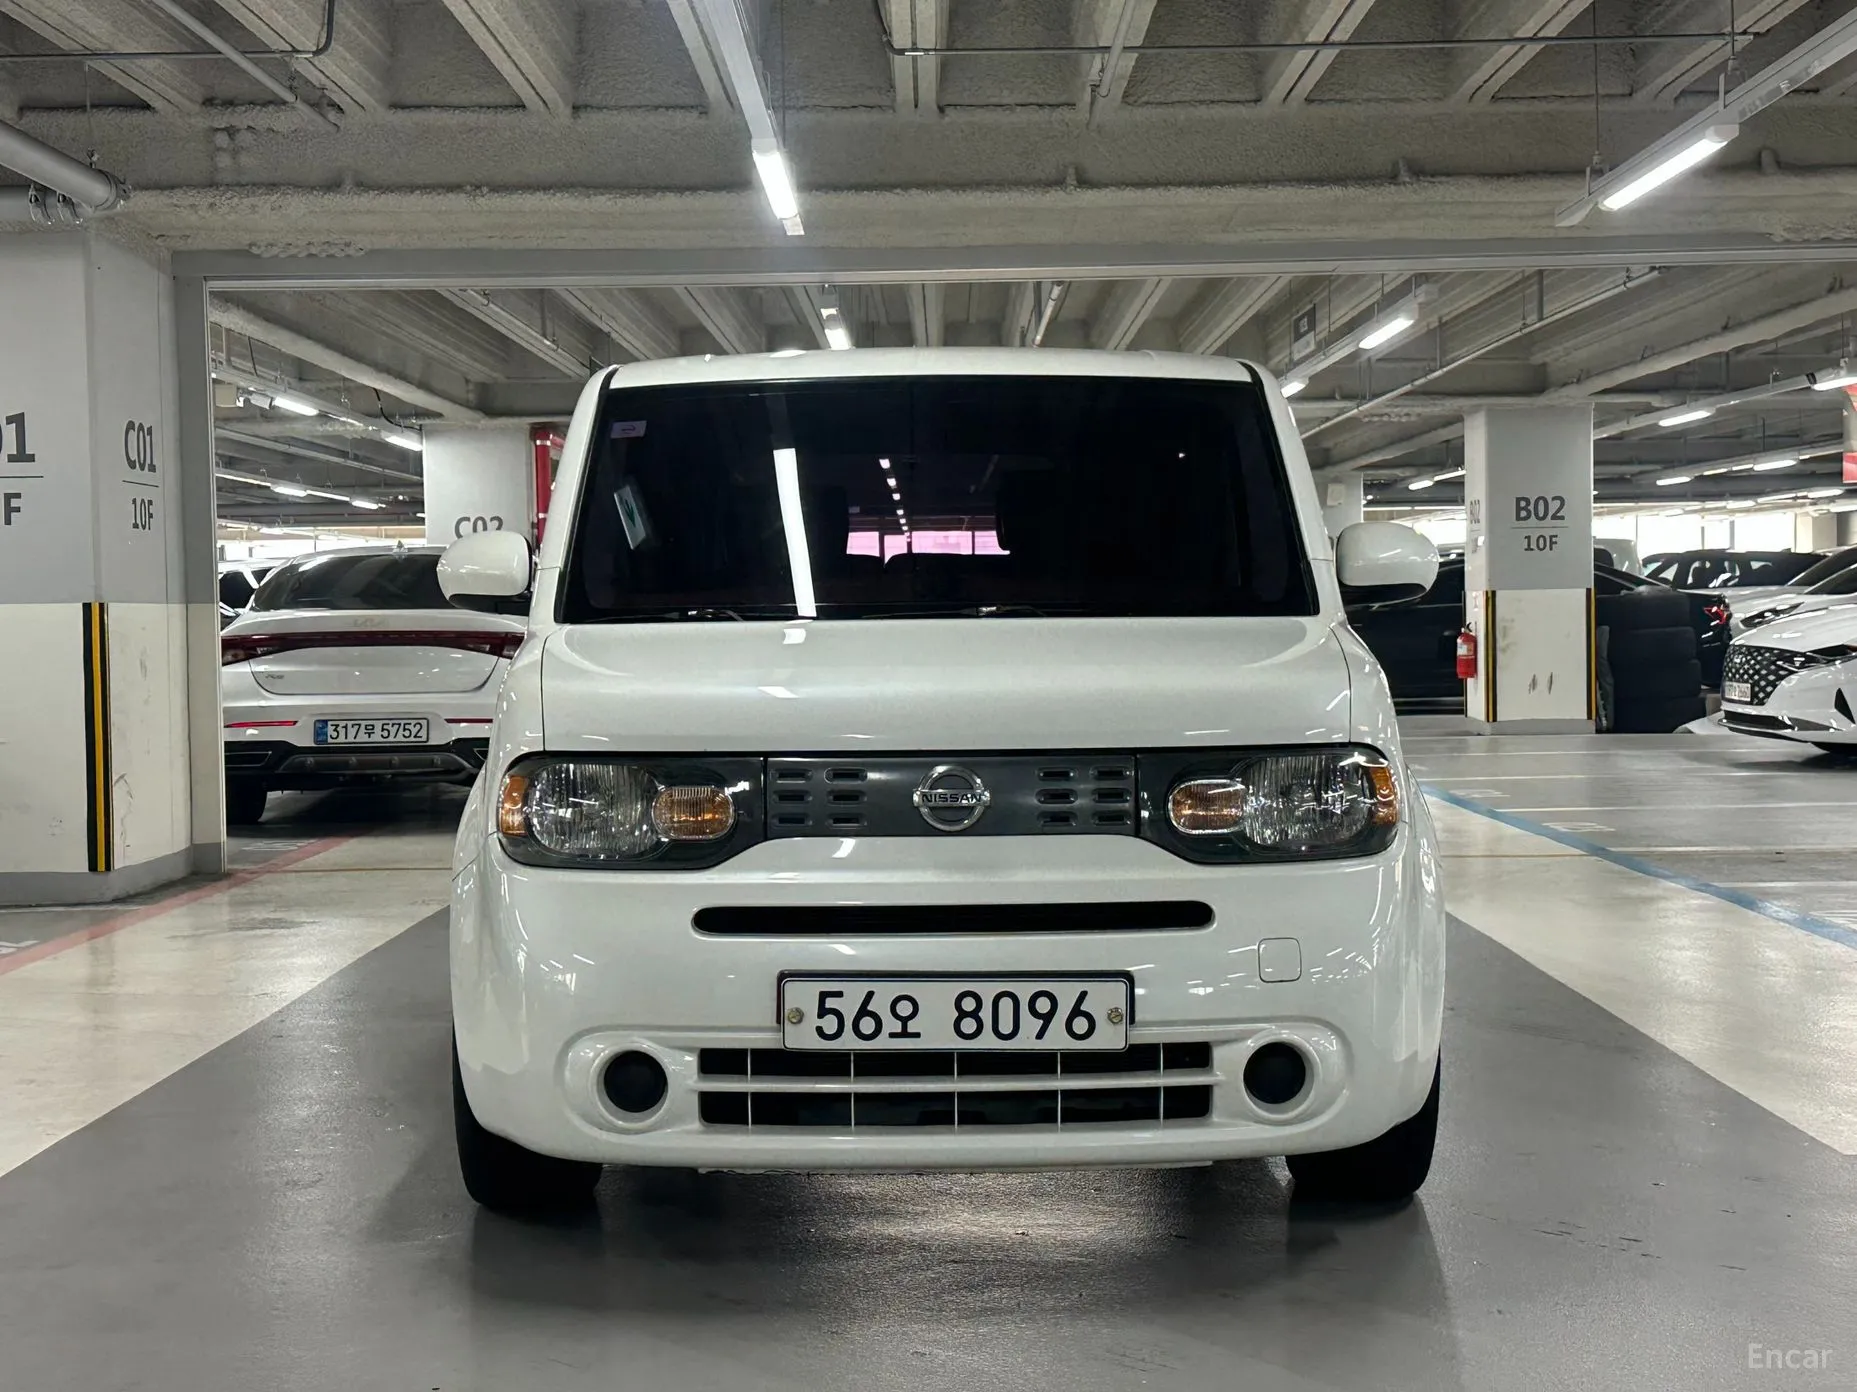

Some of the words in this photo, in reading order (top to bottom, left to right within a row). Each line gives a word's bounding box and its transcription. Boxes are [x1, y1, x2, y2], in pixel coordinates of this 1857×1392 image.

[0, 411, 36, 463] 1
[124, 419, 157, 473] C01
[131, 497, 154, 531] 10F
[1515, 495, 1566, 522] B02
[1523, 534, 1559, 552] 10F
[329, 722, 376, 740] 317무
[380, 721, 423, 740] 5752
[921, 792, 983, 804] NISSAN
[814, 989, 922, 1042] 56오
[952, 989, 1097, 1042] 8096
